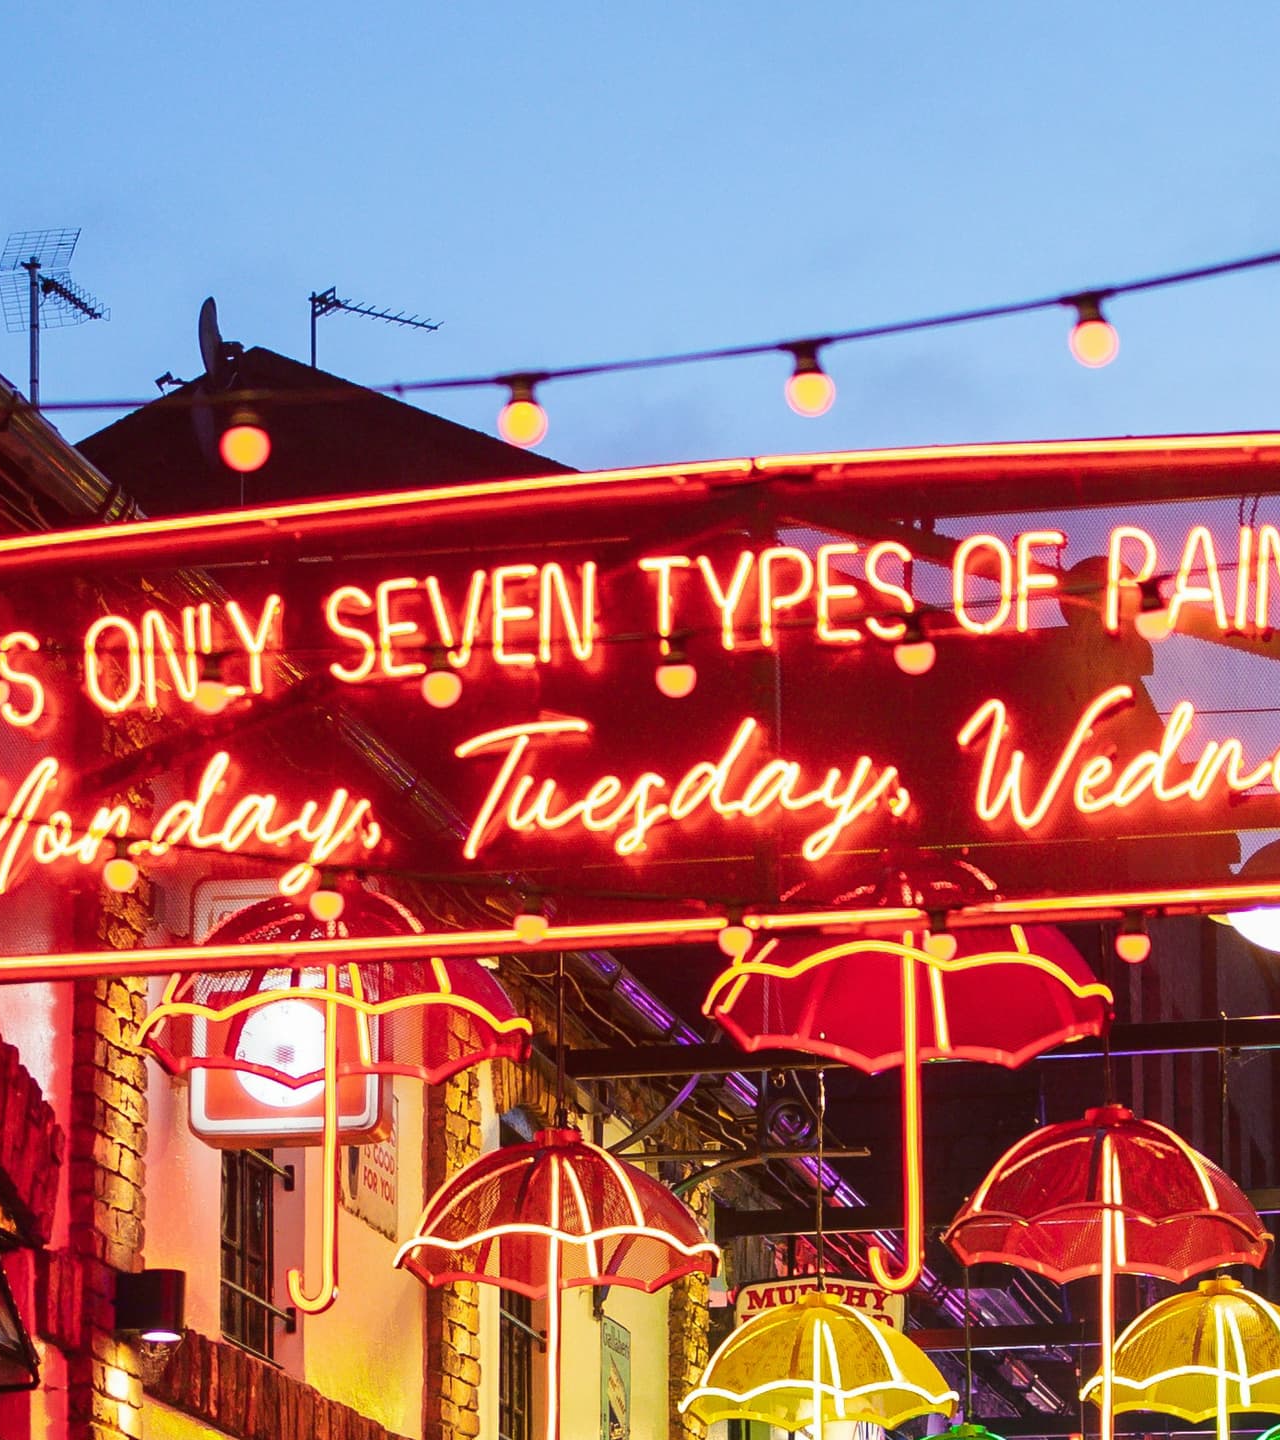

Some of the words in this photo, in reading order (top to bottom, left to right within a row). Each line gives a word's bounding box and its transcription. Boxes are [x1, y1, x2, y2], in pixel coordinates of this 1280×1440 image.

[84, 594, 281, 716] ONLY
[325, 558, 600, 684] SEVEN
[639, 540, 915, 654] TYPES
[953, 530, 1068, 637] OF
[454, 718, 910, 862] Tuesday,
[363, 1164, 379, 1196] FOR
[380, 1178, 396, 1206] YOU
[372, 1143, 396, 1177] GOOD
